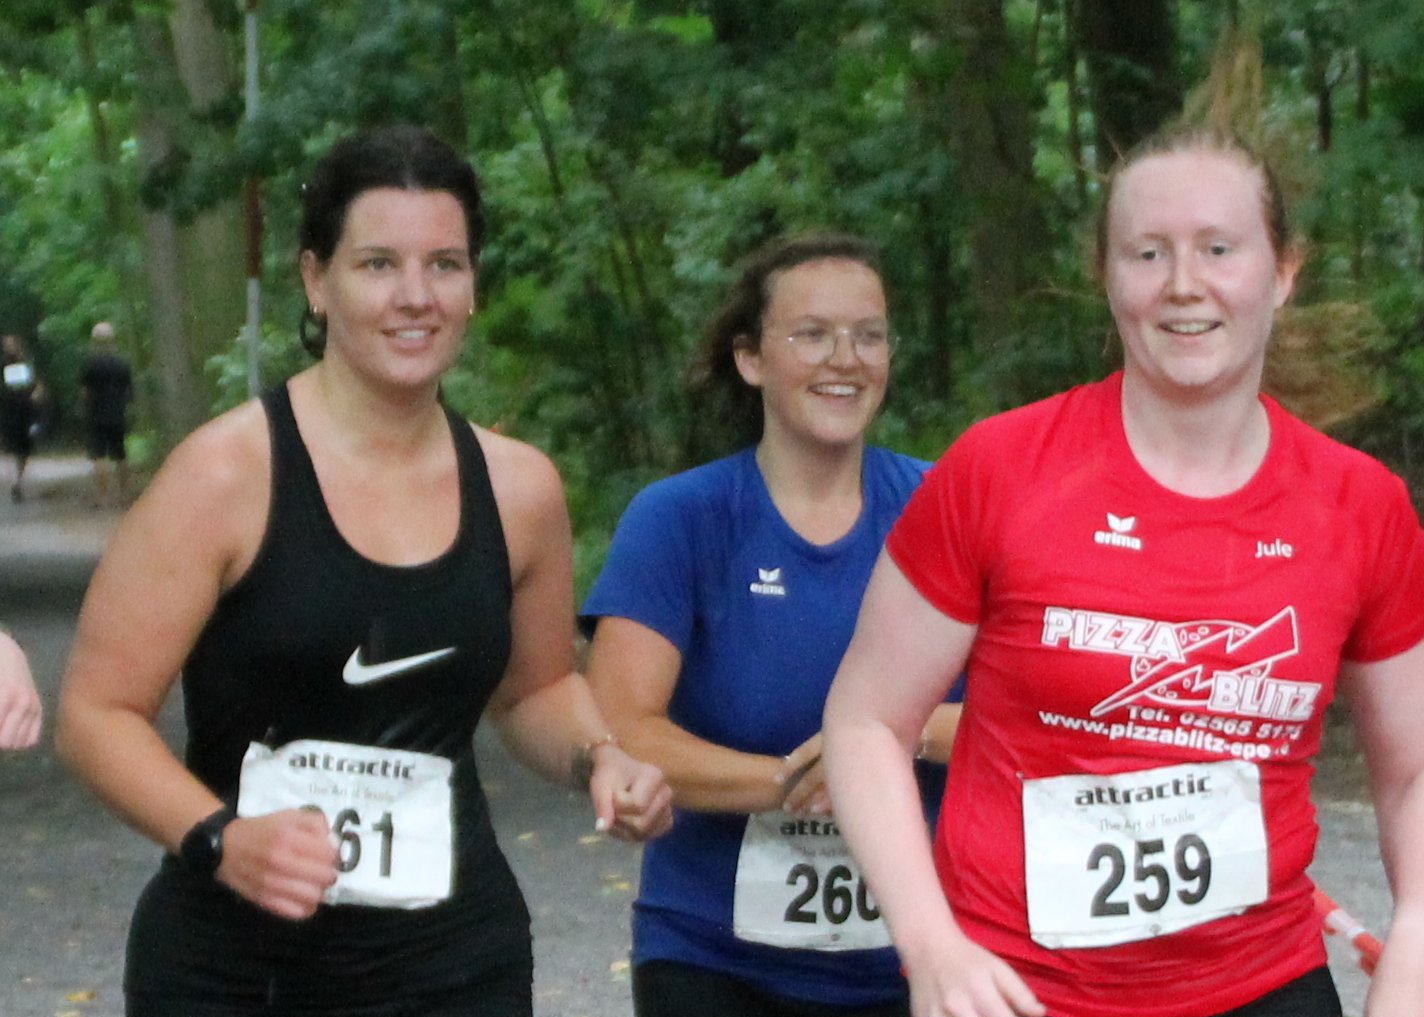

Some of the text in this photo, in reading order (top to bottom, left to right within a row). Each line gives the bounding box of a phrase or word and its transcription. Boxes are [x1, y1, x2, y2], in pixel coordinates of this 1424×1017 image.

[1093, 530, 1142, 550] erima
[1254, 538, 1293, 558] Jule
[1041, 606, 1186, 663] PIZZA
[1207, 670, 1322, 721] BLITZ
[288, 752, 416, 780] attractic
[1075, 773, 1212, 806] attractic
[300, 803, 395, 879] 61
[1086, 833, 1212, 918] 259
